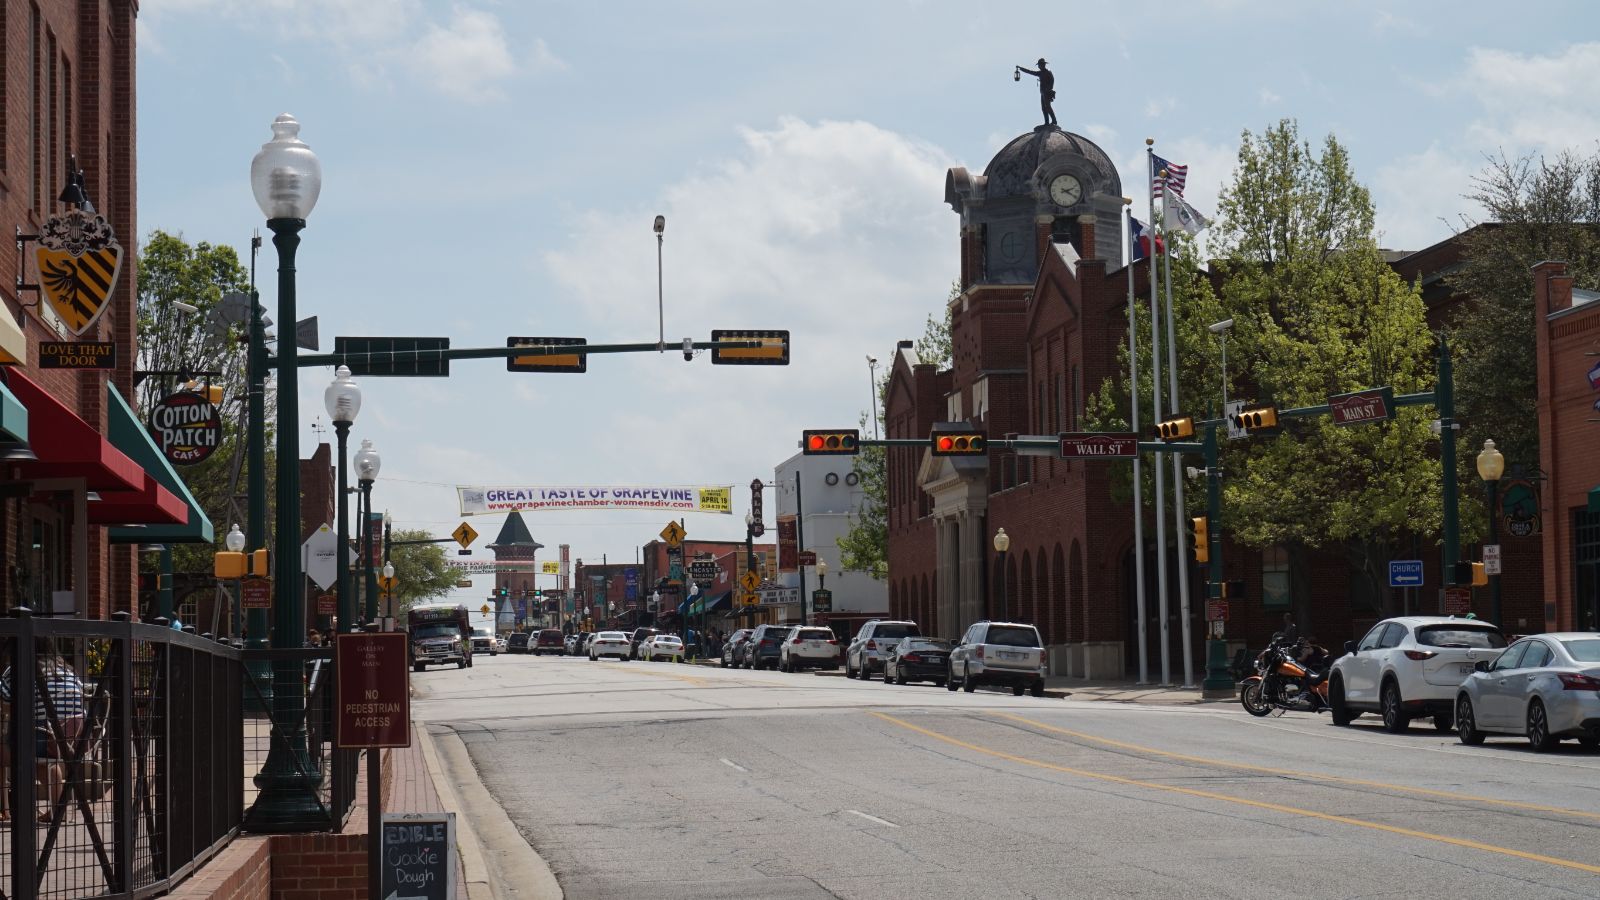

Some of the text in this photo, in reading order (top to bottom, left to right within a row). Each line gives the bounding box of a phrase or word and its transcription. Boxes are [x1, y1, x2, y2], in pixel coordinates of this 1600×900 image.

[41, 345, 113, 356] LOVE THAT
[59, 355, 97, 366] DOOR
[152, 403, 211, 431] COTTON
[1342, 405, 1376, 421] MAIN ST
[163, 428, 216, 453] PATCH
[173, 448, 201, 460] CAFE
[1076, 444, 1123, 455] WALL ST
[487, 490, 533, 502] GREAT
[541, 489, 582, 500] TASTE
[588, 488, 609, 500] OF
[612, 488, 693, 501] GRAPEVINE
[1393, 565, 1420, 573] CHURCH
[365, 689, 379, 701] NO
[346, 702, 400, 714] PEDESTRIAN
[355, 716, 391, 727] ACCESS
[385, 825, 446, 845] EDIBLE
[388, 847, 440, 867] Cookie
[396, 868, 434, 889] Dough
